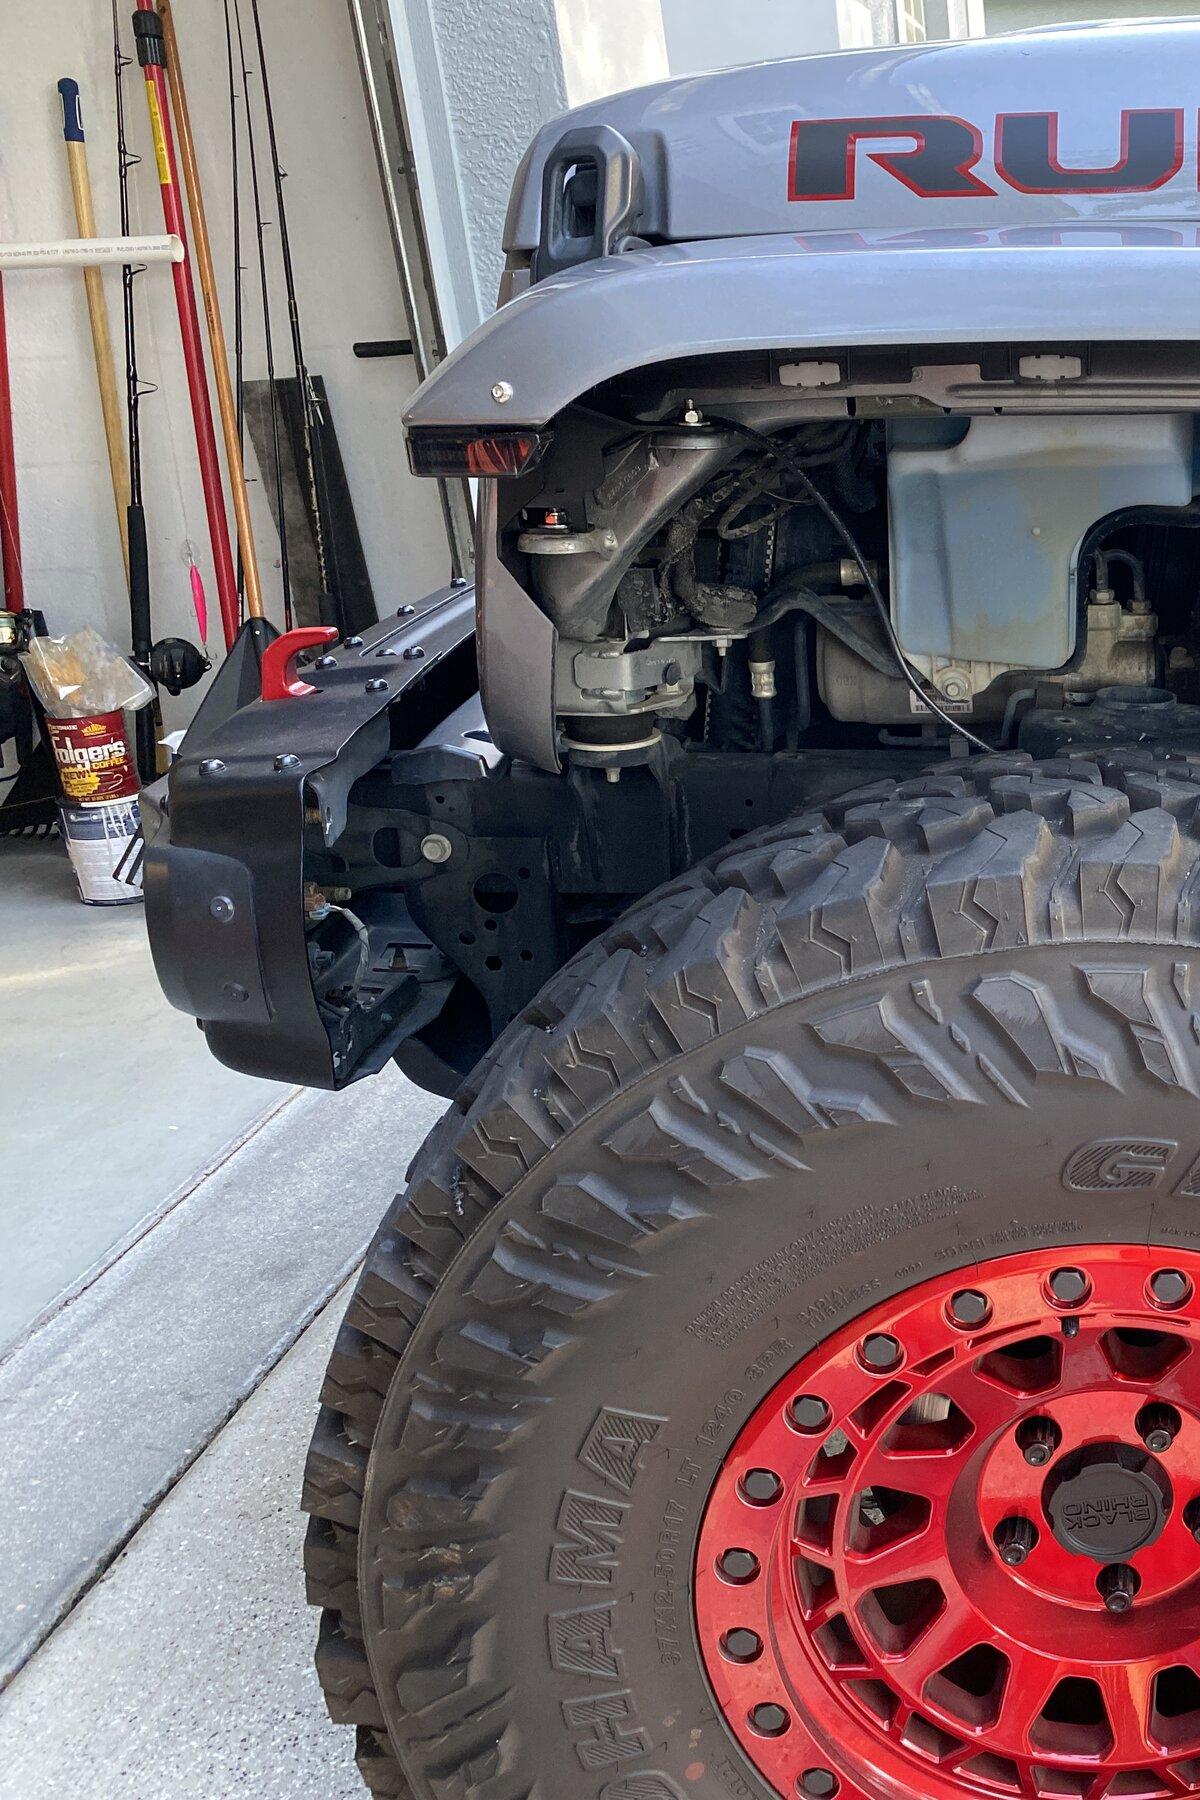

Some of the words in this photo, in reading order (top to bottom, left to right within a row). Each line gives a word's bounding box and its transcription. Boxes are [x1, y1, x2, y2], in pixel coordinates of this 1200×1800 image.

[91, 757, 125, 769] COFFEE
[794, 1281, 850, 1323] RADIAL
[804, 1275, 883, 1330] TUBELESS
[673, 1456, 704, 1487] LT
[1063, 1494, 1149, 1516] RHINO
[1066, 1508, 1151, 1530] BLACK
